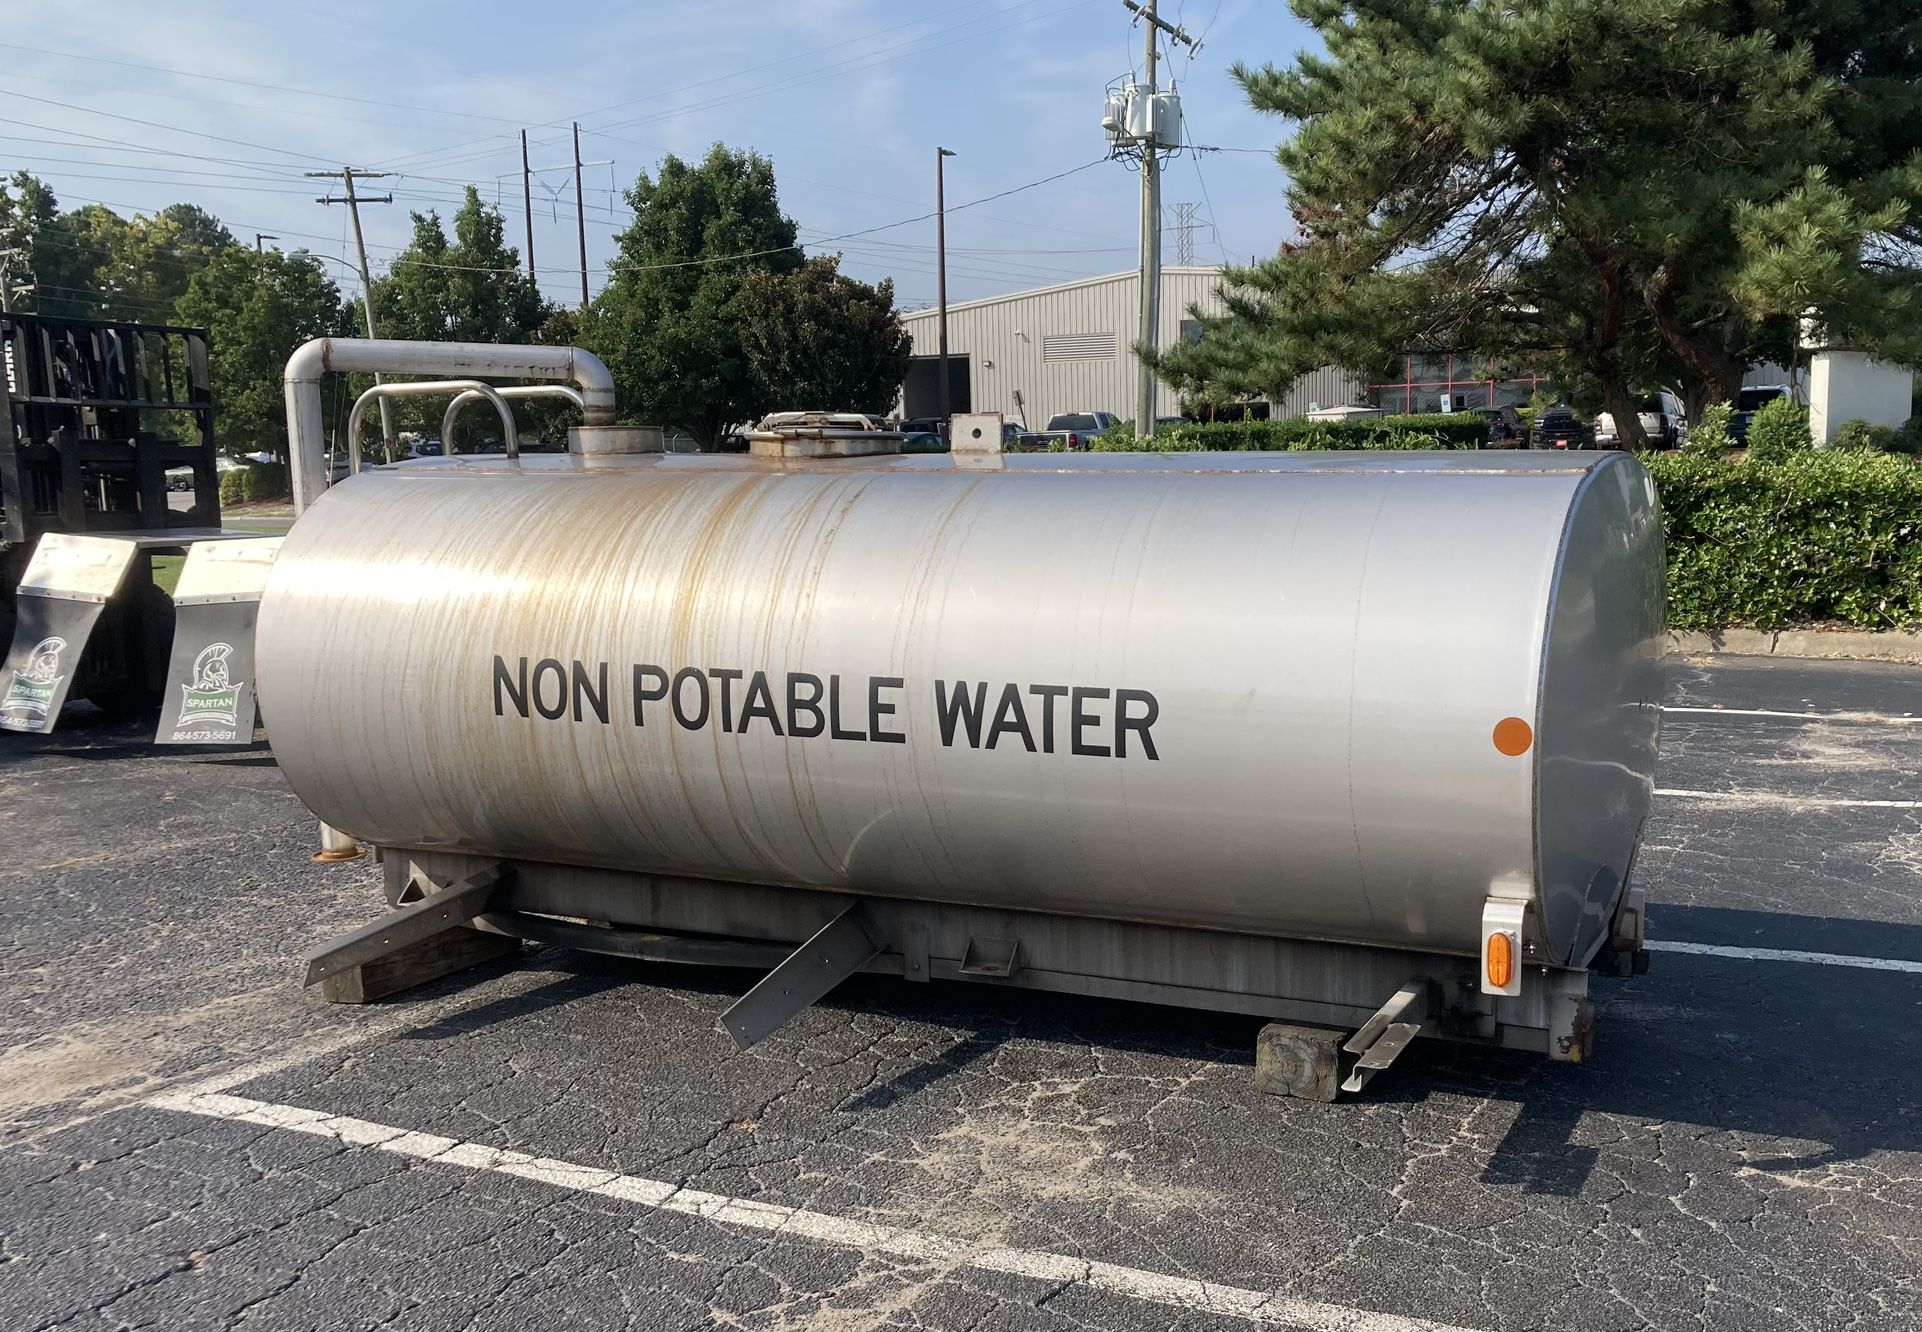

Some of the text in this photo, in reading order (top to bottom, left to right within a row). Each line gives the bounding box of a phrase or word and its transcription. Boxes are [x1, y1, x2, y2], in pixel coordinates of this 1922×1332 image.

[11, 684, 52, 698] SPARTAN
[186, 697, 233, 708] SPARTAN
[493, 655, 1160, 761] NON POTABLE WATER
[172, 731, 237, 740] 864-573-5691
